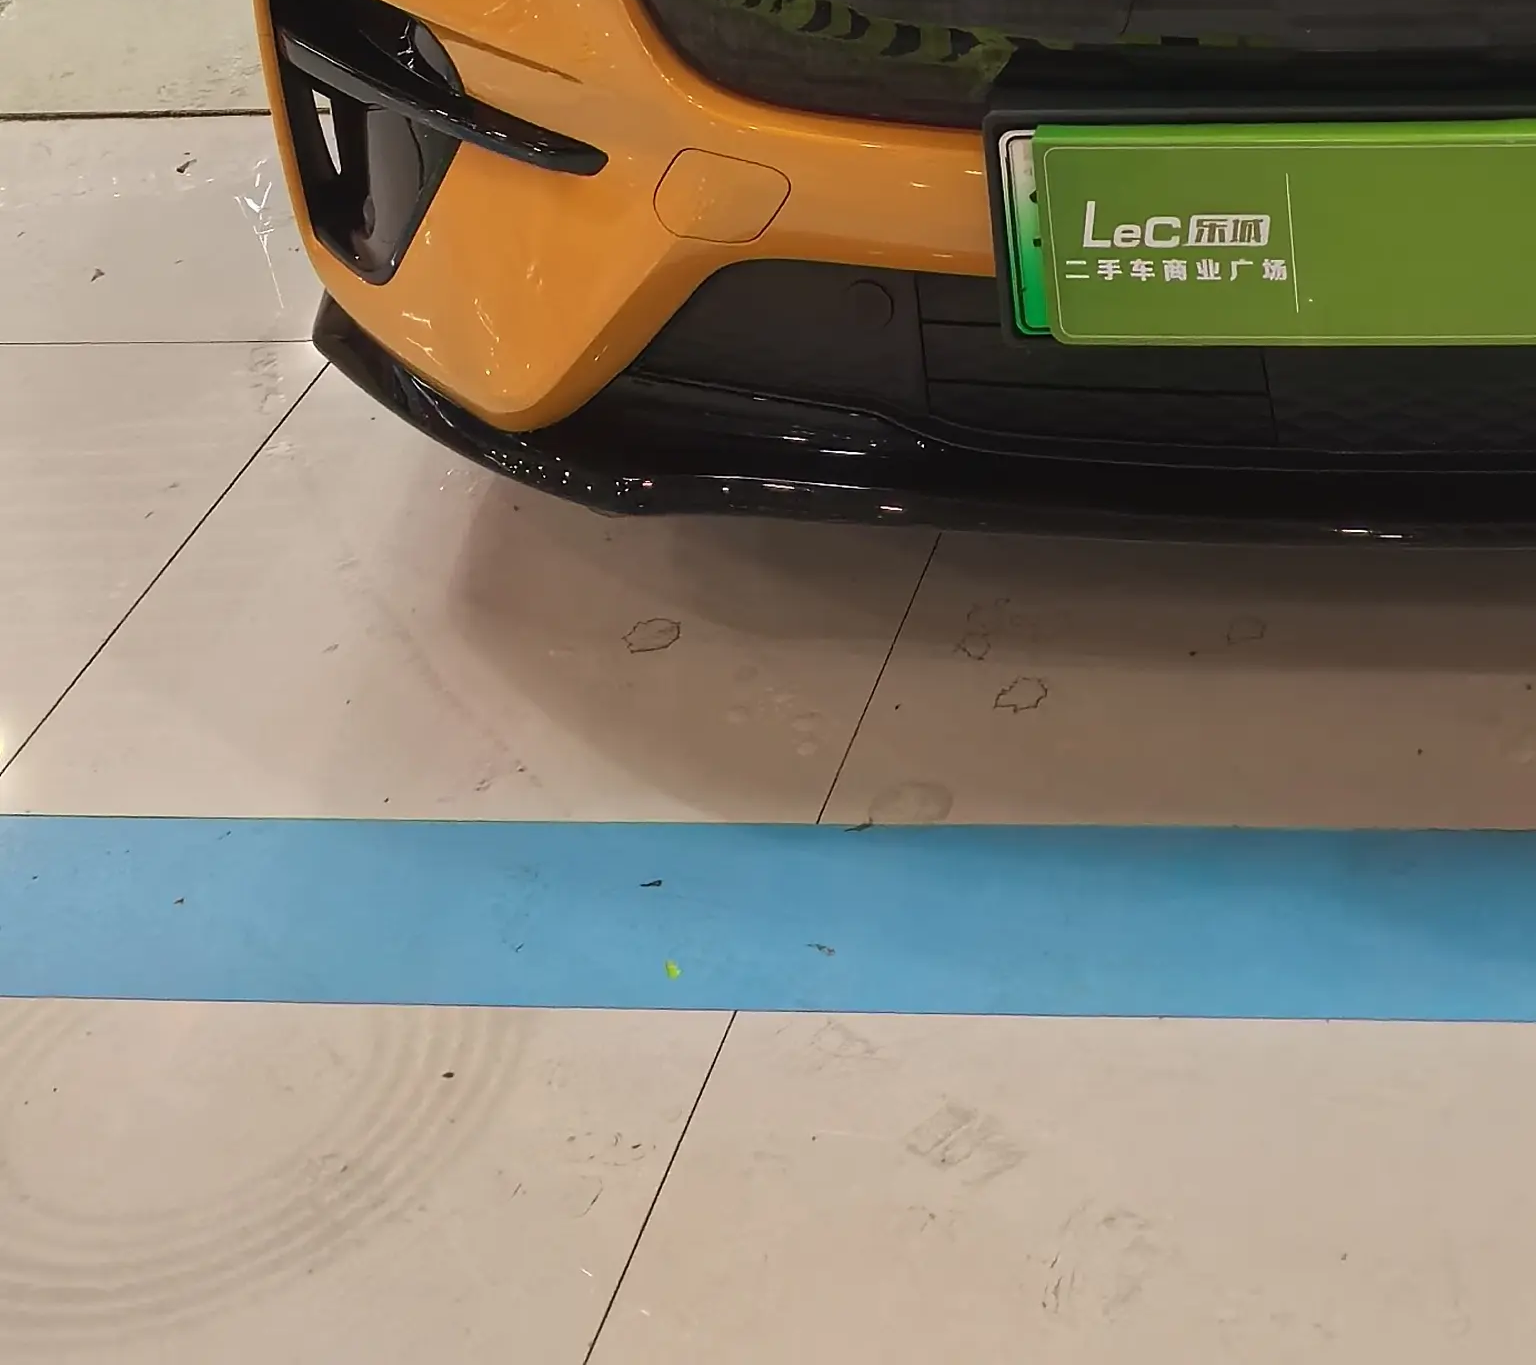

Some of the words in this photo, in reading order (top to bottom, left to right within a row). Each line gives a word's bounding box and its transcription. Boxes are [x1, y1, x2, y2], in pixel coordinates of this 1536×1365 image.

[1083, 200, 1181, 249] LeC
[1065, 258, 1288, 282] 二手车商业广场
